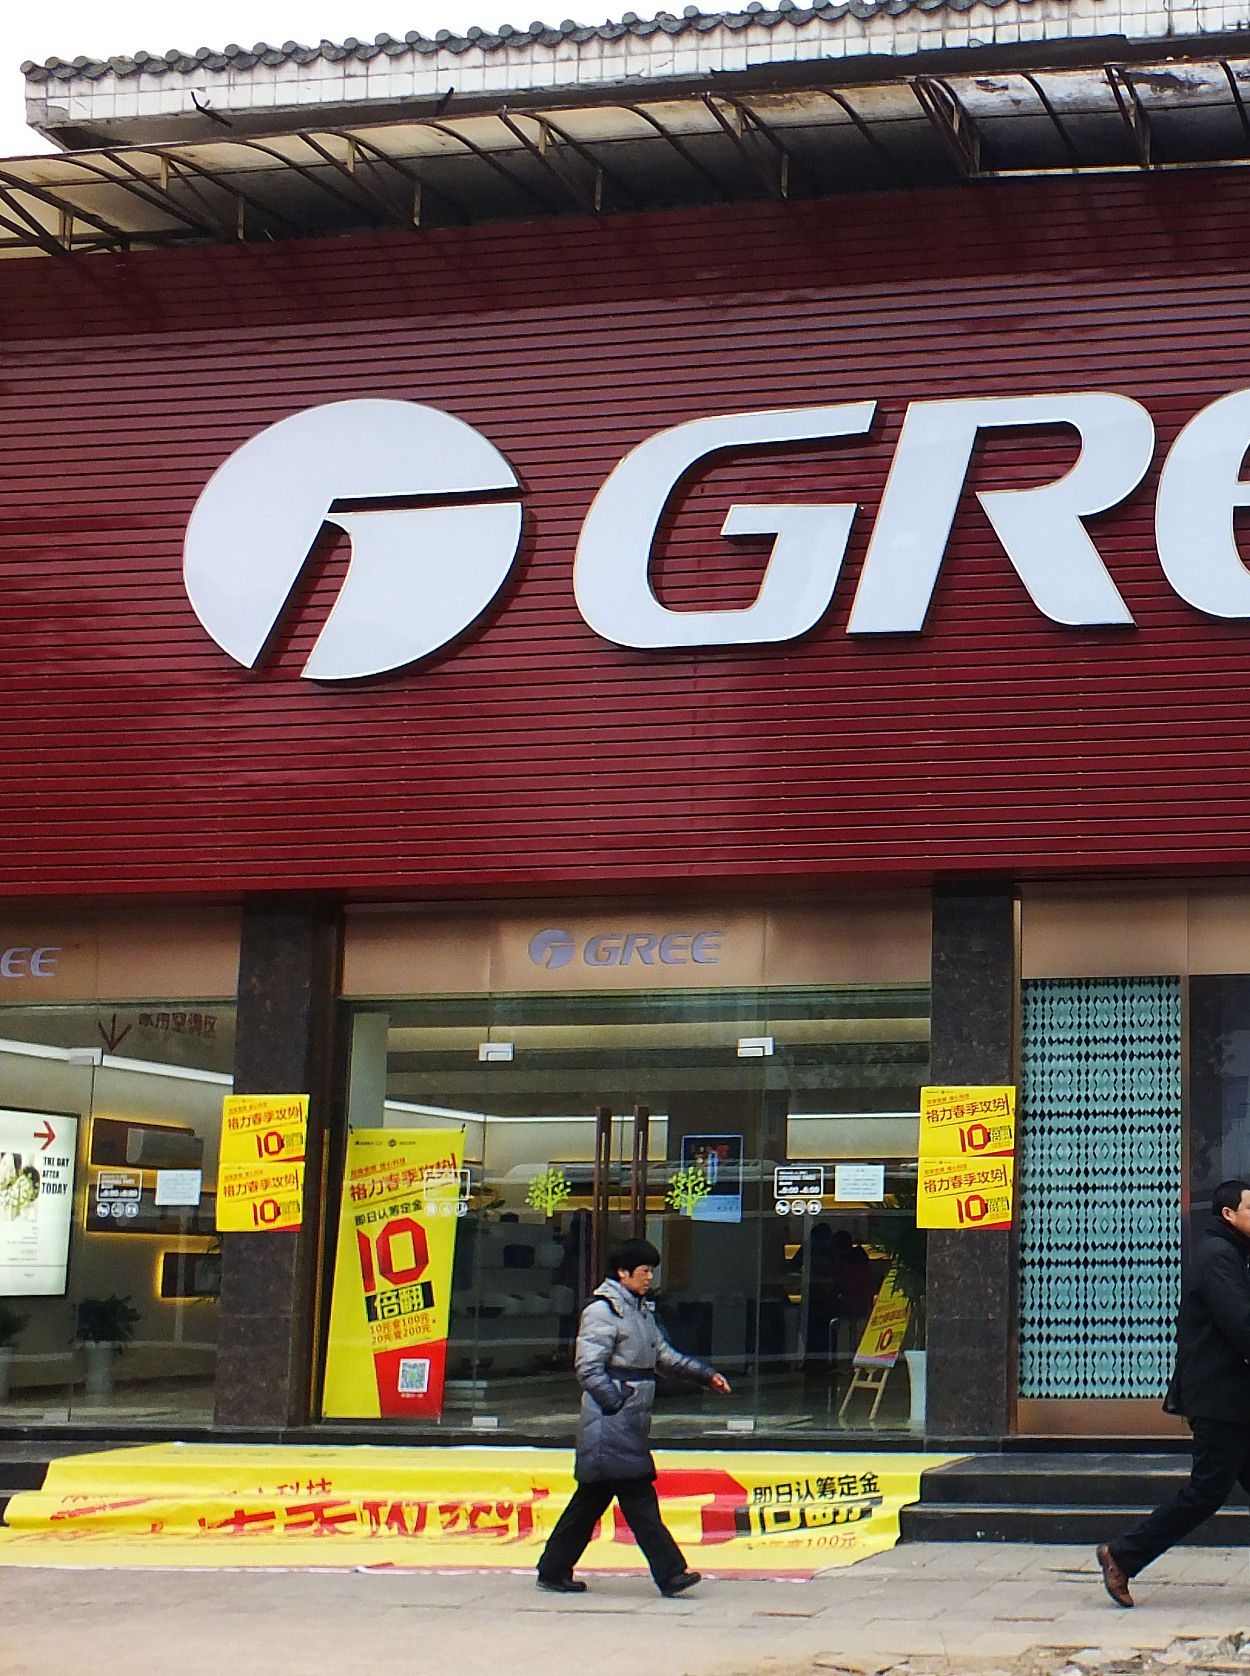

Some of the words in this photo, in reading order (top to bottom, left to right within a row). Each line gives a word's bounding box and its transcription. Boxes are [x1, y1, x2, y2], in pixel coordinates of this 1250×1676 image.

[583, 931, 727, 966] GREE
[256, 1131, 284, 1158] 10
[959, 1123, 988, 1152] 10
[42, 1170, 60, 1179] AFTER
[56, 1157, 69, 1167] DAY
[41, 1183, 68, 1195] TODAY
[252, 1200, 280, 1226] 10
[957, 1194, 986, 1223] 10
[356, 1217, 430, 1293] 10
[753, 1472, 880, 1504] 即日认筹定金
